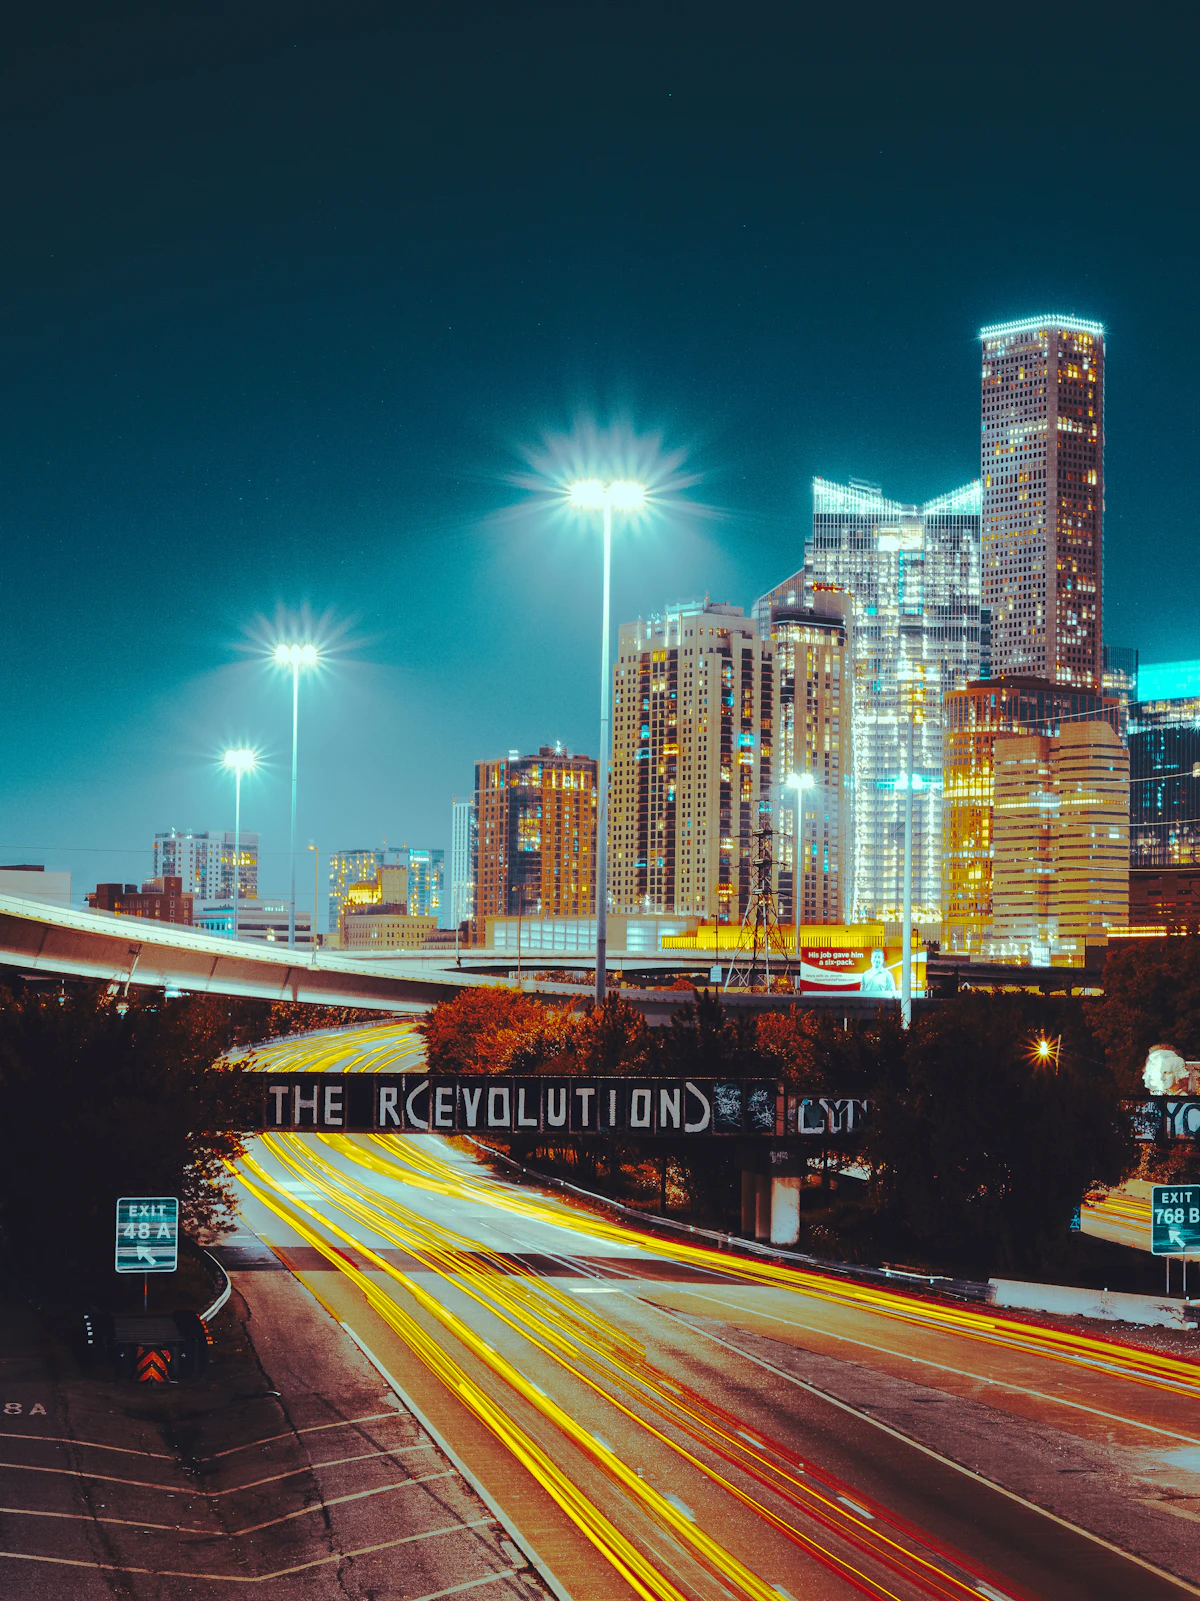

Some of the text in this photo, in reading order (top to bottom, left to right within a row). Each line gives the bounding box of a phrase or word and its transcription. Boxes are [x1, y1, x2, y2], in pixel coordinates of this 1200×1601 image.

[820, 951, 832, 959] job
[824, 958, 855, 967] six-pack.
[269, 1085, 343, 1126] THE
[379, 1079, 711, 1133] R(EVOLUTION)
[1161, 1191, 1193, 1204] EXIT
[128, 1204, 167, 1218] EXIT
[1154, 1207, 1200, 1225] 768 B
[123, 1222, 171, 1240] 48 A
[28, 1402, 48, 1416] A
